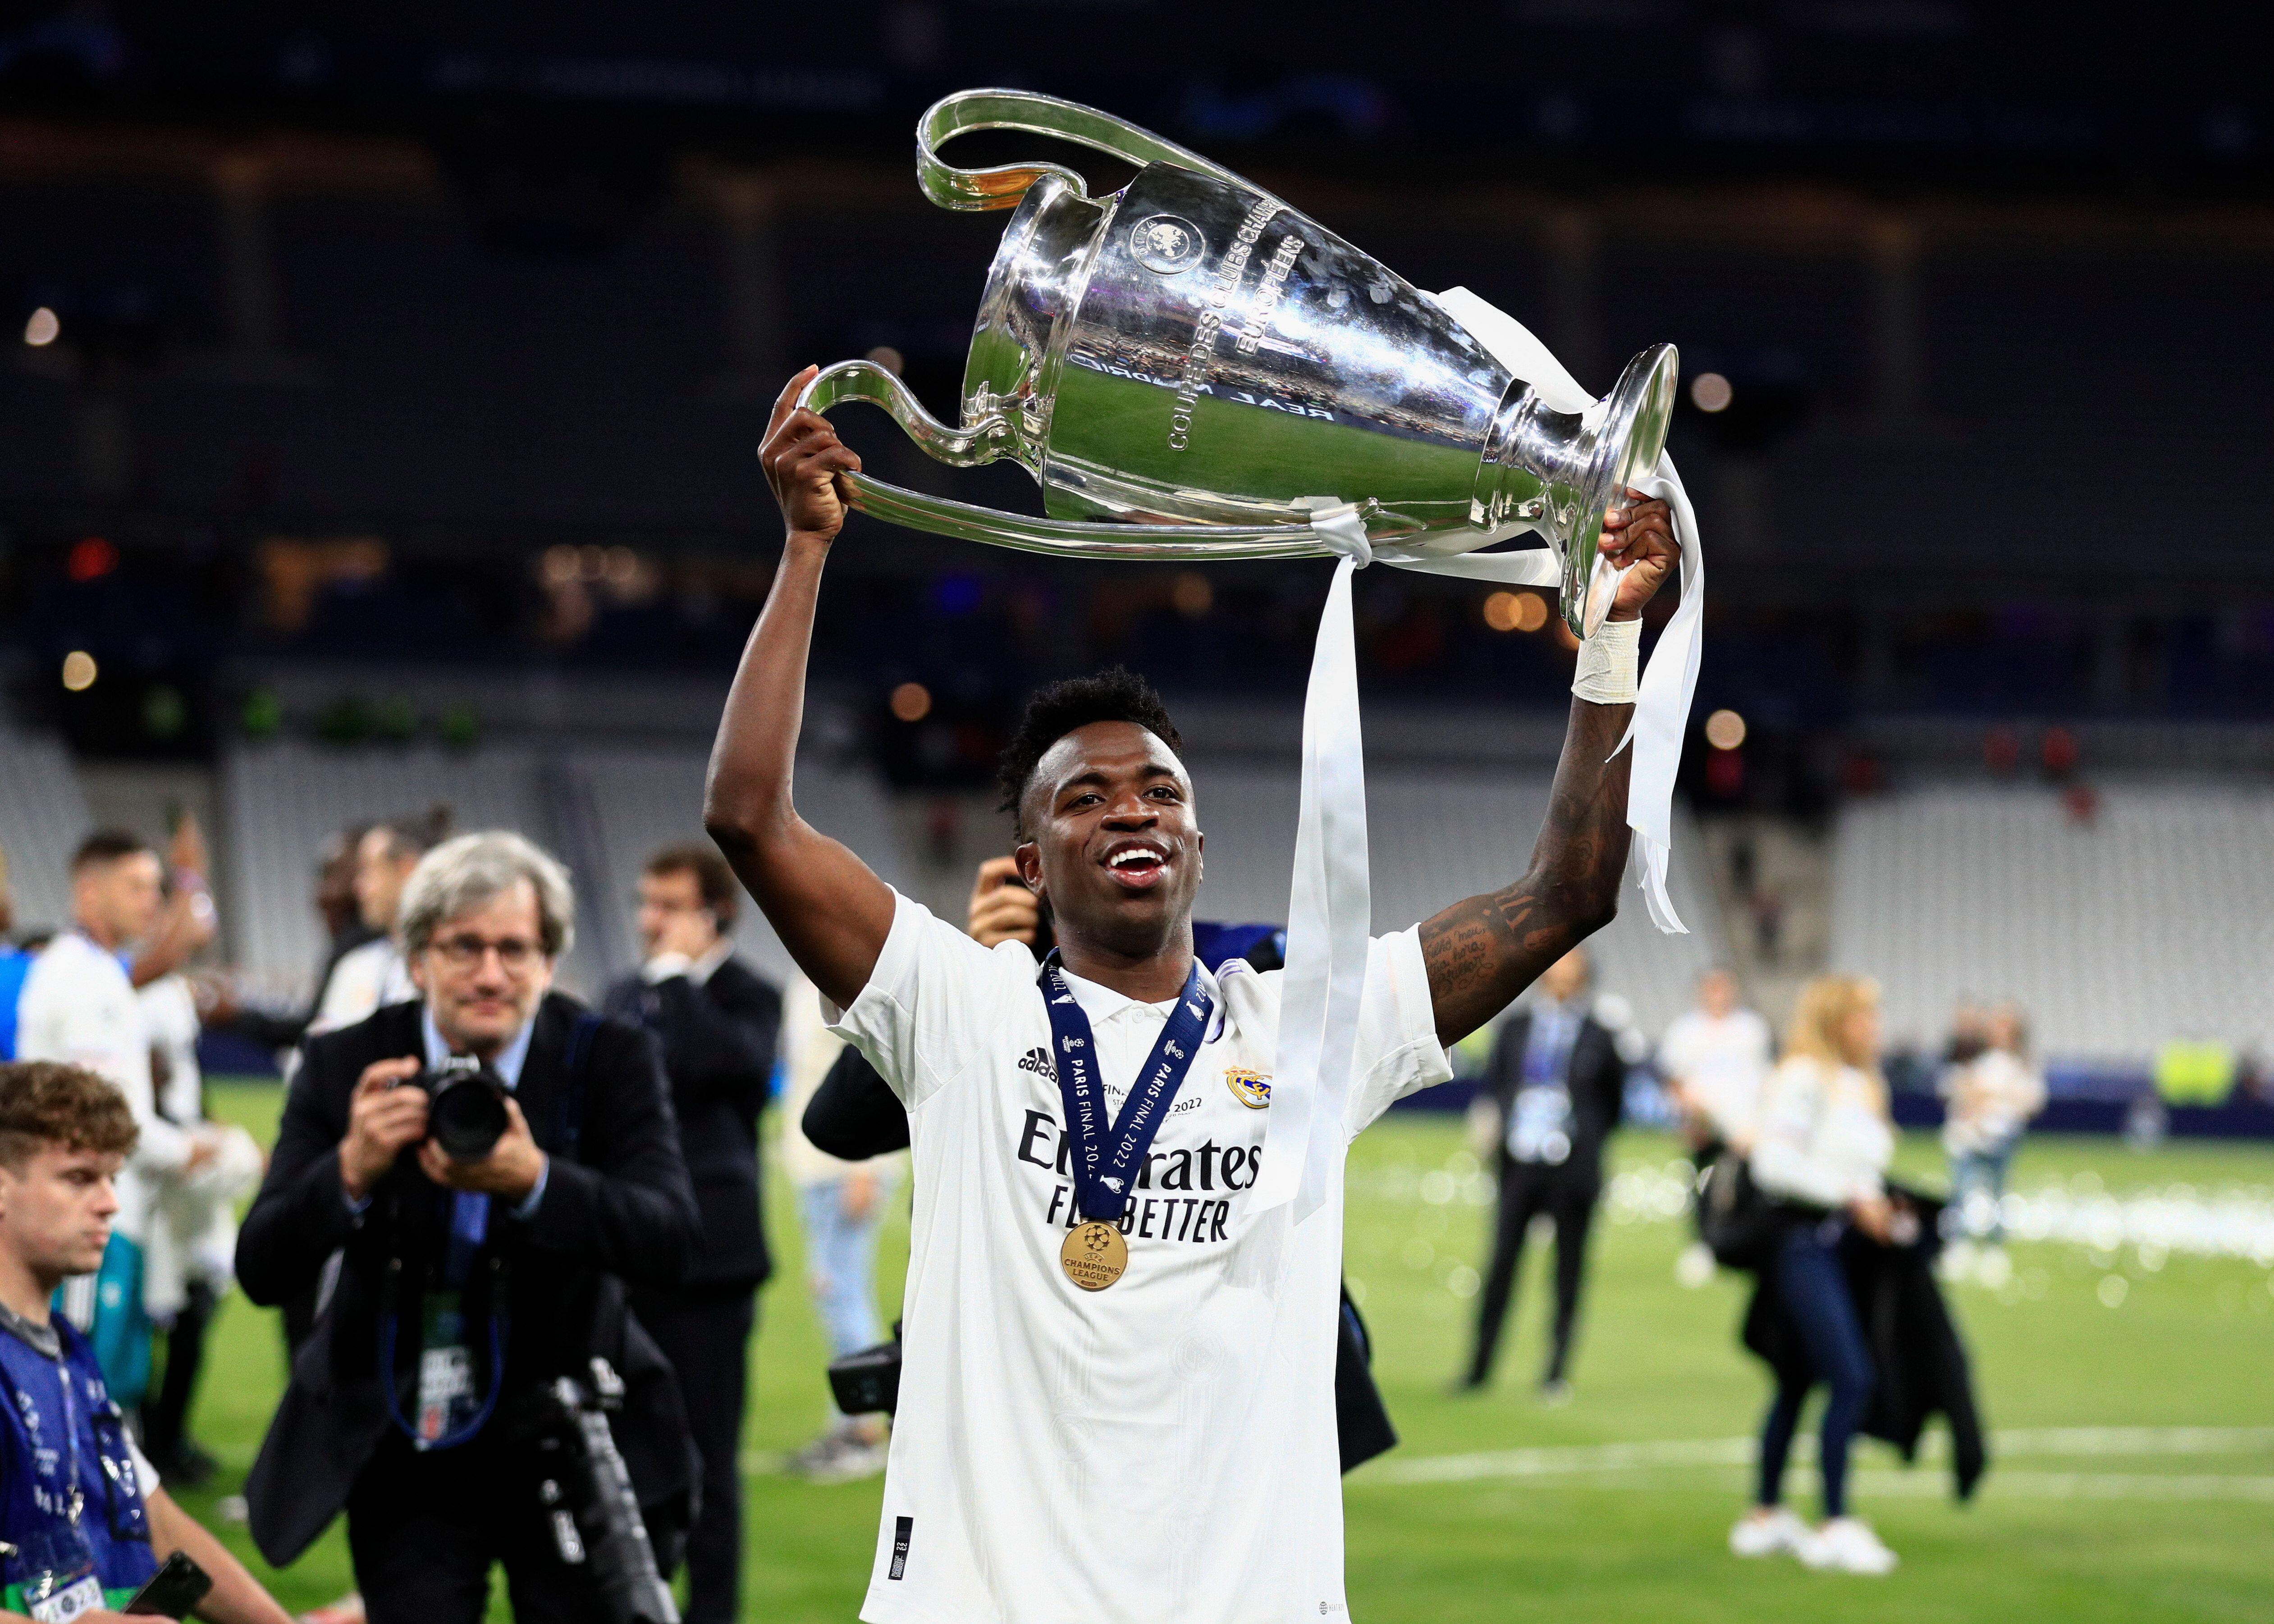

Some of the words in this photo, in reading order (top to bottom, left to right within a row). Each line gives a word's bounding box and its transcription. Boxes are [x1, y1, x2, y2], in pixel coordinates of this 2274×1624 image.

[1167, 363, 1207, 451] COUPE
[1190, 310, 1222, 362] DES
[1210, 240, 1252, 308] CLUBS
[1018, 1057, 1058, 1083] adida
[1071, 1059, 1089, 1097] PARIS
[1147, 1063, 1172, 1098] PARIS
[1079, 1101, 1095, 1140] FINAL
[1129, 1098, 1154, 1131] FINAL
[1174, 1098, 1202, 1112] 2022
[1018, 1109, 1262, 1191] Erates
[1113, 1133, 1137, 1168] 2022
[1047, 1185, 1079, 1229] FL
[1119, 1195, 1230, 1243] BETTER
[1065, 1259, 1121, 1275] CHAMPIONS
[1072, 1268, 1109, 1281] LEAGUE
[1084, 1253, 1104, 1263] UEFA
